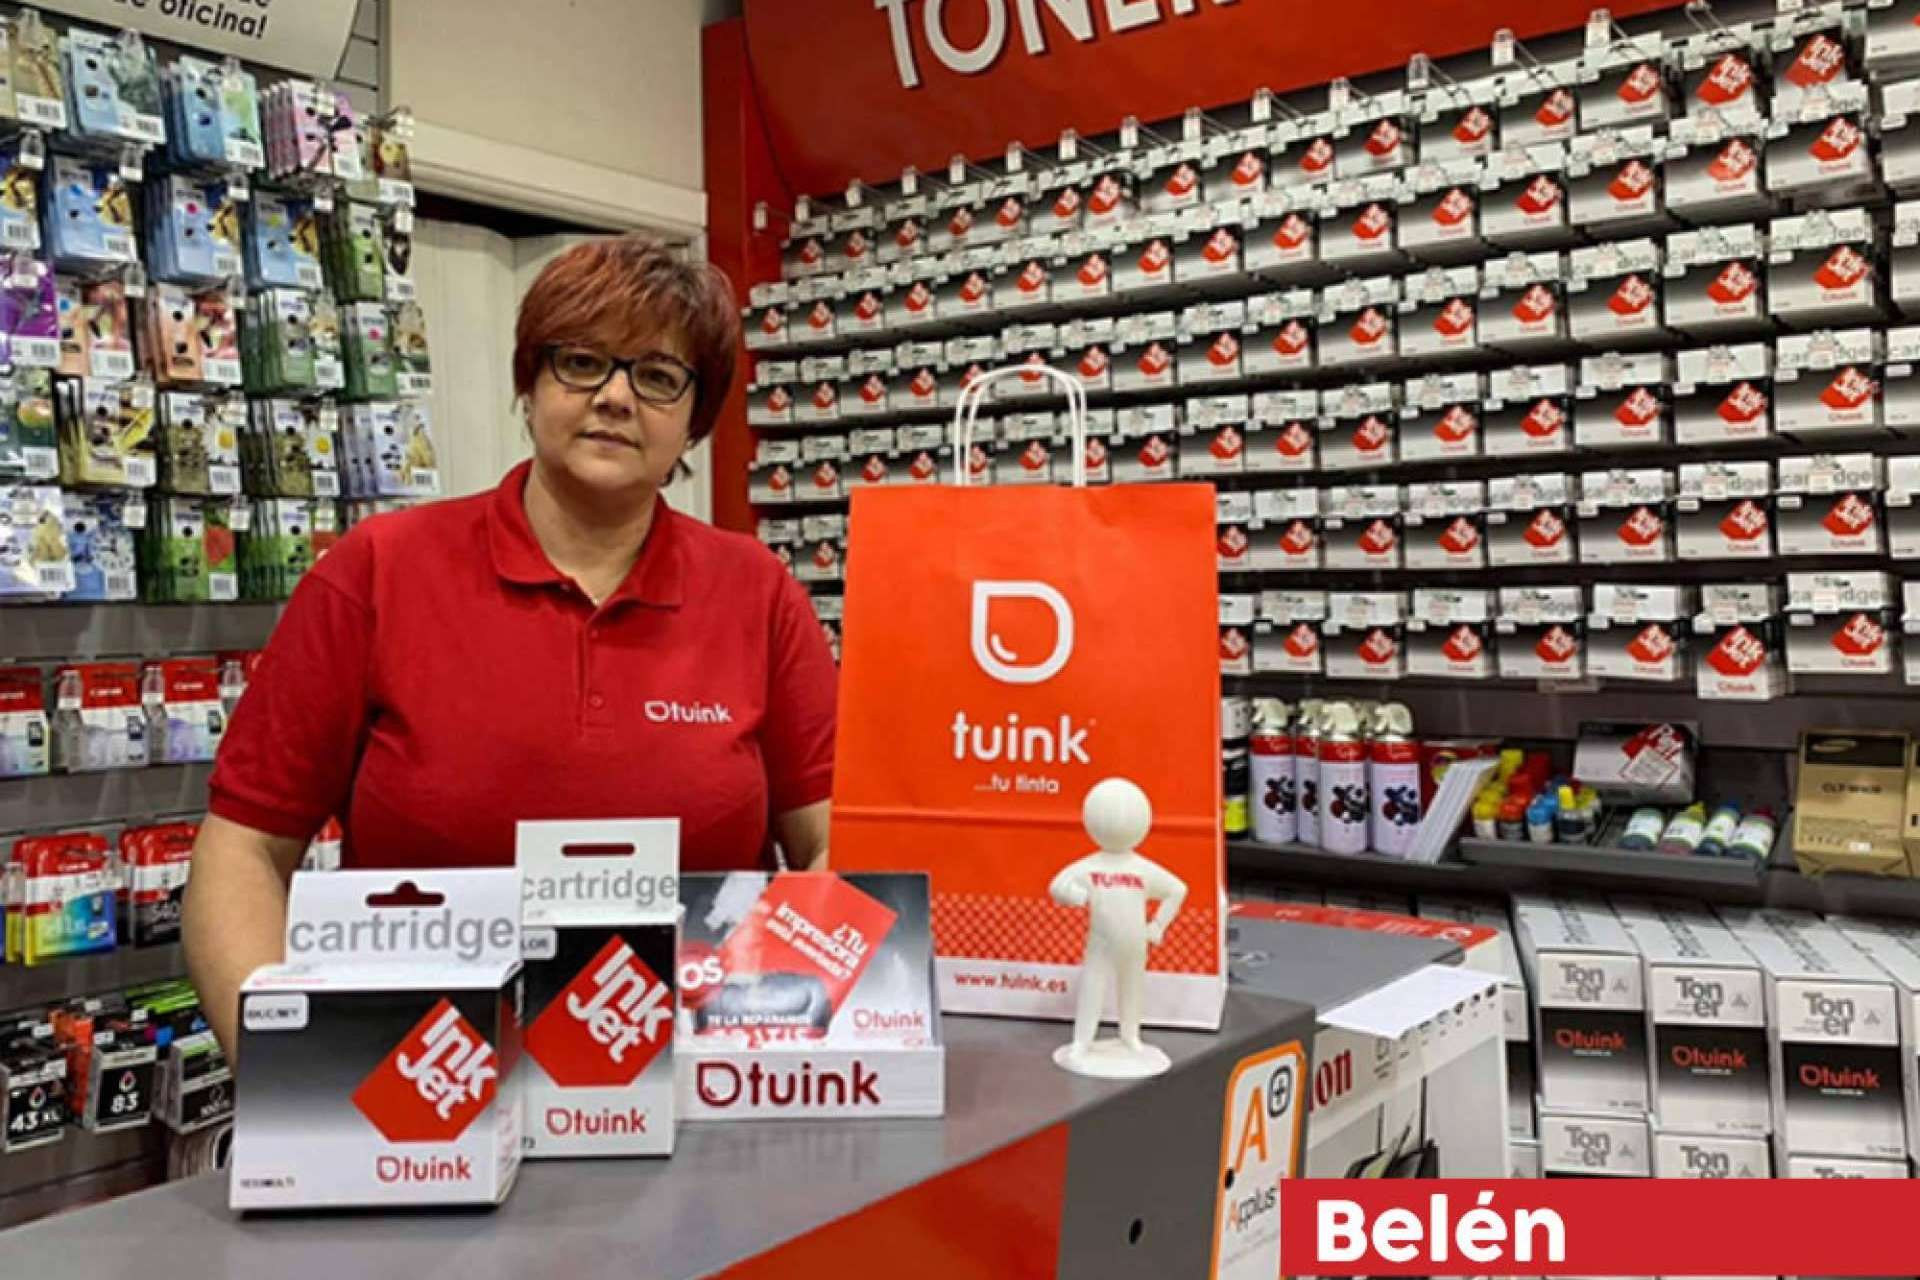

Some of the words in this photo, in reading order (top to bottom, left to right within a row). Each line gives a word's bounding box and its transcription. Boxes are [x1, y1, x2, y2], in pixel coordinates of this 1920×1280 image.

[951, 711, 1091, 764] tuink
[521, 869, 679, 907] cartridge
[290, 909, 514, 962] cartridge
[567, 975, 642, 1064] Jet
[593, 943, 673, 1043] Ink
[396, 1030, 468, 1121] Jet
[420, 1004, 499, 1101] Ink
[748, 1060, 881, 1106] tuink
[573, 1107, 648, 1136] tuink
[400, 1157, 472, 1181] tuink
